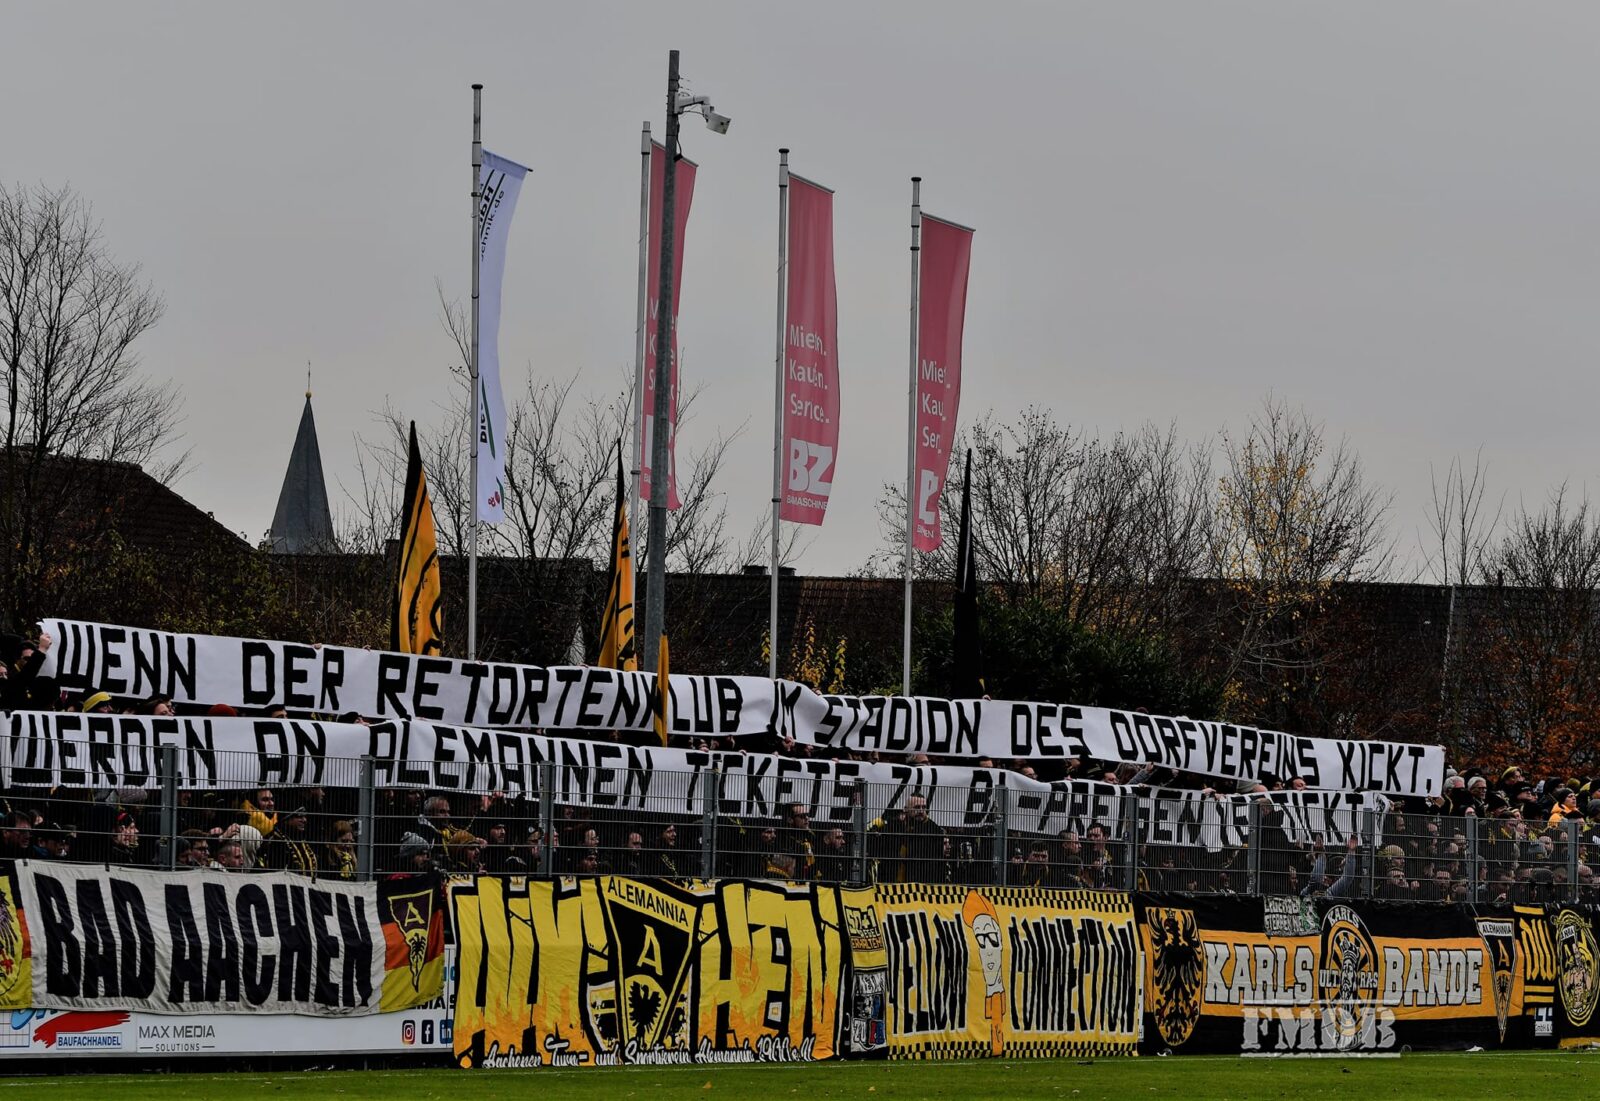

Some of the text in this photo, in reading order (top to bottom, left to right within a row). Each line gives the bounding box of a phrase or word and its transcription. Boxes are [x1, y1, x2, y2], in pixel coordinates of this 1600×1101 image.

[789, 438, 833, 497] BZ
[56, 621, 197, 701] WENN
[242, 641, 345, 711] DER
[814, 694, 981, 756] STADION
[1010, 703, 1092, 757] DES
[1110, 711, 1320, 789] DORFVEREINS
[10, 712, 217, 786] WERDEN
[253, 721, 327, 785] AN
[368, 720, 654, 809] ALEMANNEN
[607, 877, 689, 927] ALEMANNIA
[1328, 907, 1360, 929] KARLS
[34, 872, 374, 1008] BAD AACHEN
[636, 924, 664, 976] A
[1203, 941, 1315, 1006] KARLS
[1383, 945, 1484, 1007] BANDE
[57, 1035, 121, 1047] BAUFACHHANDEL
[139, 1025, 215, 1039] MAX MEDIA
[155, 1043, 200, 1052] SOLUTIONS
